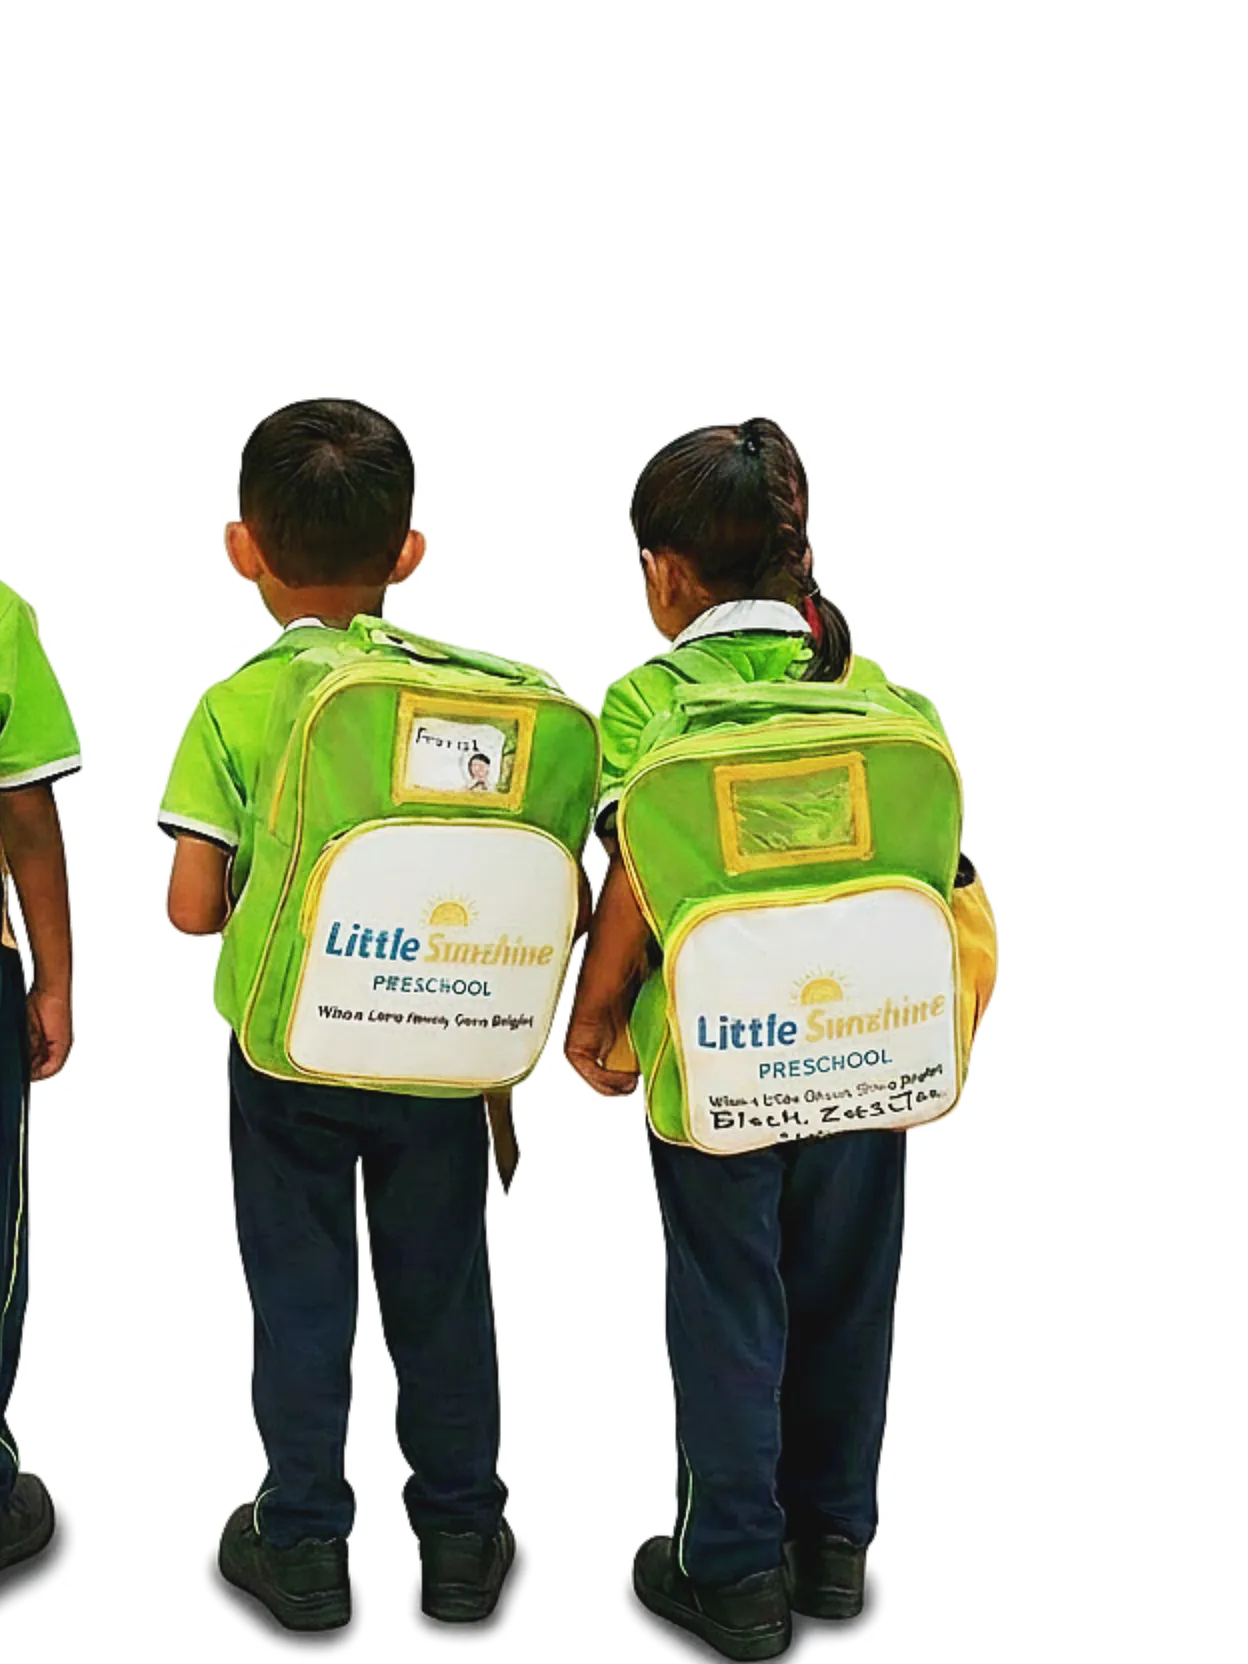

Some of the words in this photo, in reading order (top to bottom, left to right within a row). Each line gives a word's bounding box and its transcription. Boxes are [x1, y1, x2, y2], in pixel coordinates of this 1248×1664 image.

[325, 921, 421, 962] Little
[698, 1013, 798, 1050] Little
[759, 1048, 893, 1080] PRESCHOOL
